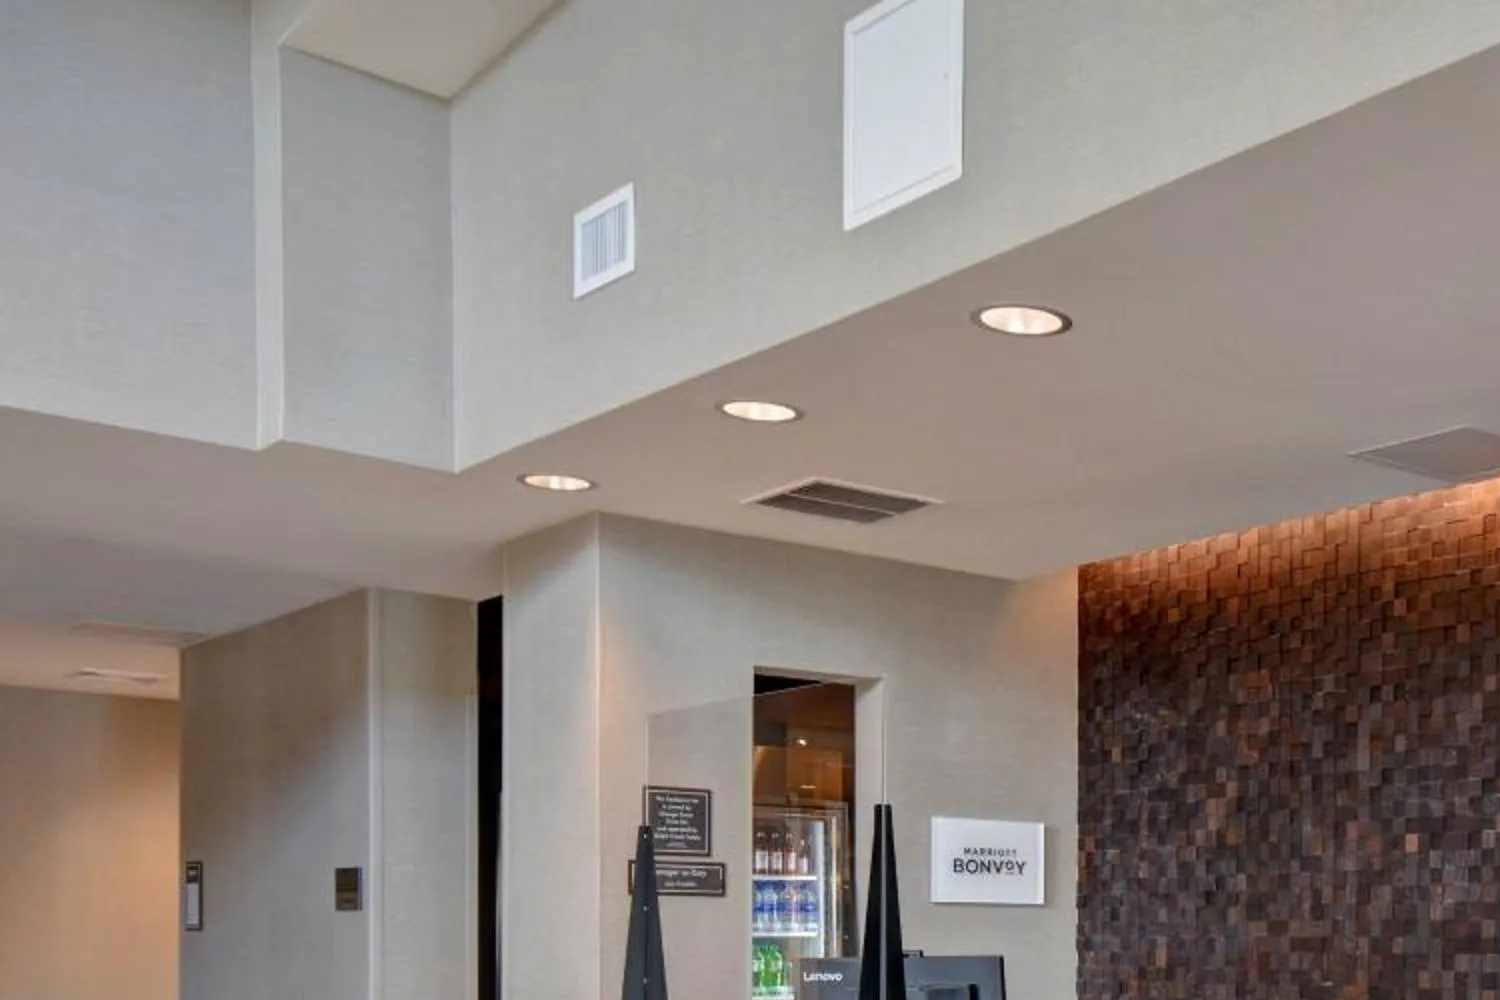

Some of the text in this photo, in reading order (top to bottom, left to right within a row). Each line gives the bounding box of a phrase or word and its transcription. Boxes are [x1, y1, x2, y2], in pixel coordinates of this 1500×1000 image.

[963, 847, 1018, 857] MARRIOTT
[952, 858, 1027, 875] BONVOY
[803, 971, 844, 982] Lenovo
